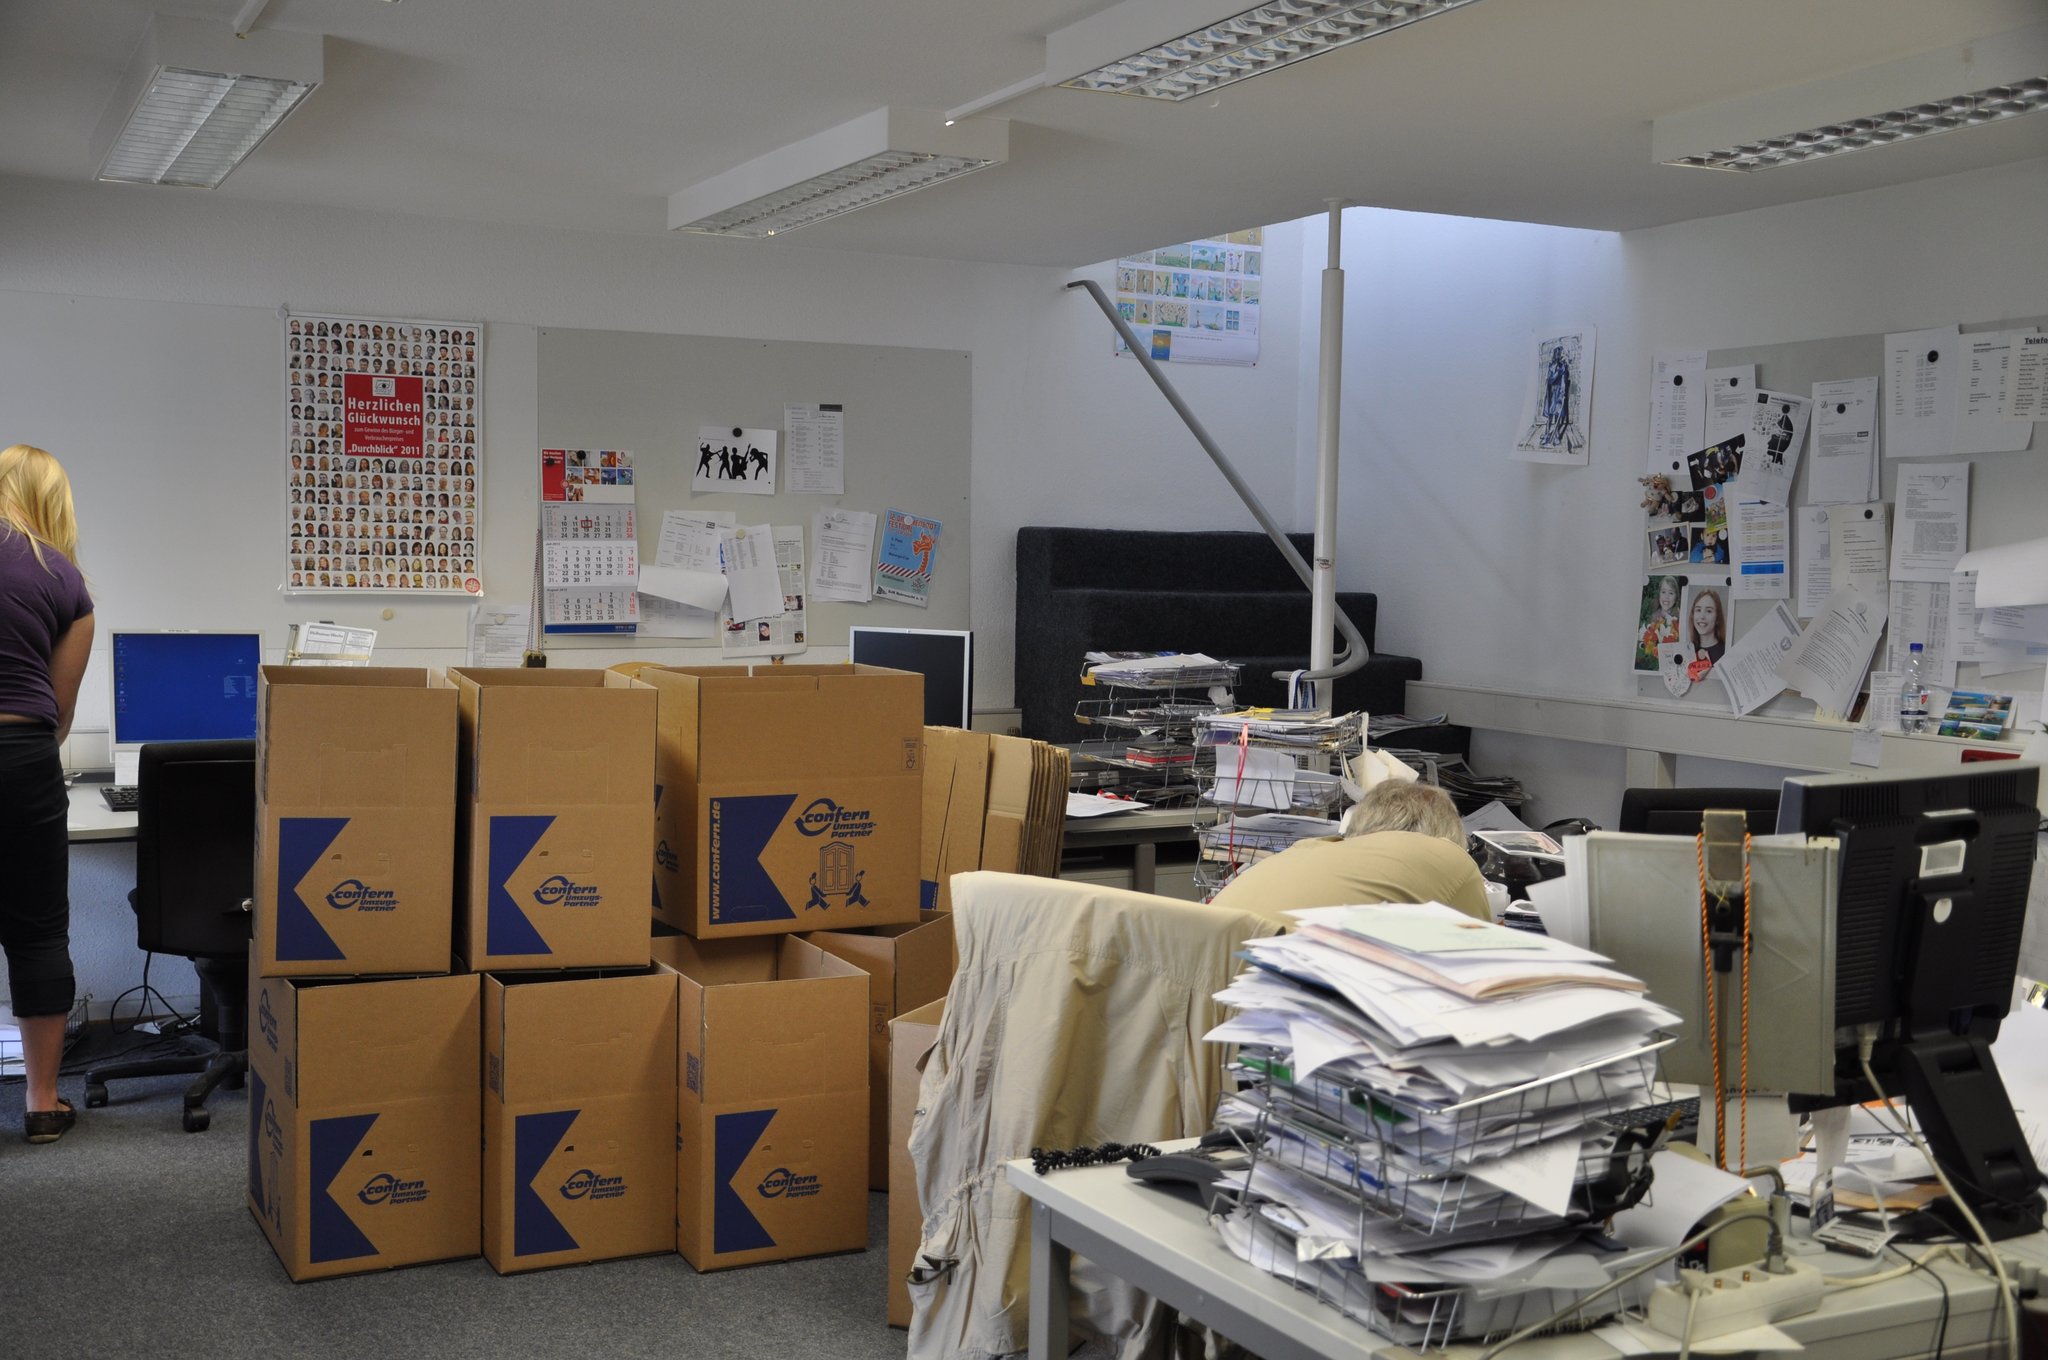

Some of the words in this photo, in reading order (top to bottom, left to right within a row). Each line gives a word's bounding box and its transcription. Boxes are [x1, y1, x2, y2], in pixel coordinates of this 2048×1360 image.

[348, 397, 420, 412] Herzlichen
[347, 412, 420, 426] Glückwunsch
[347, 443, 398, 454] „Durchblick“
[400, 446, 420, 455] 2011
[804, 806, 870, 826] confern
[832, 820, 878, 832] Umzugs-
[830, 828, 873, 839] Partner
[711, 800, 722, 920] www.confern.de
[334, 886, 394, 900] confern
[542, 882, 598, 896] confern
[359, 899, 400, 907] Umzugs-
[563, 900, 600, 908] Partner
[567, 1174, 623, 1190] confern
[765, 1173, 818, 1189] confern
[366, 1179, 425, 1196] confern
[591, 1184, 628, 1194] Umzugs-
[787, 1182, 823, 1193] Umzugs-
[389, 1195, 427, 1205] Partner
[391, 1189, 430, 1199] Umzugs-
[589, 1191, 625, 1200] Partner
[785, 1189, 820, 1199] Partner
